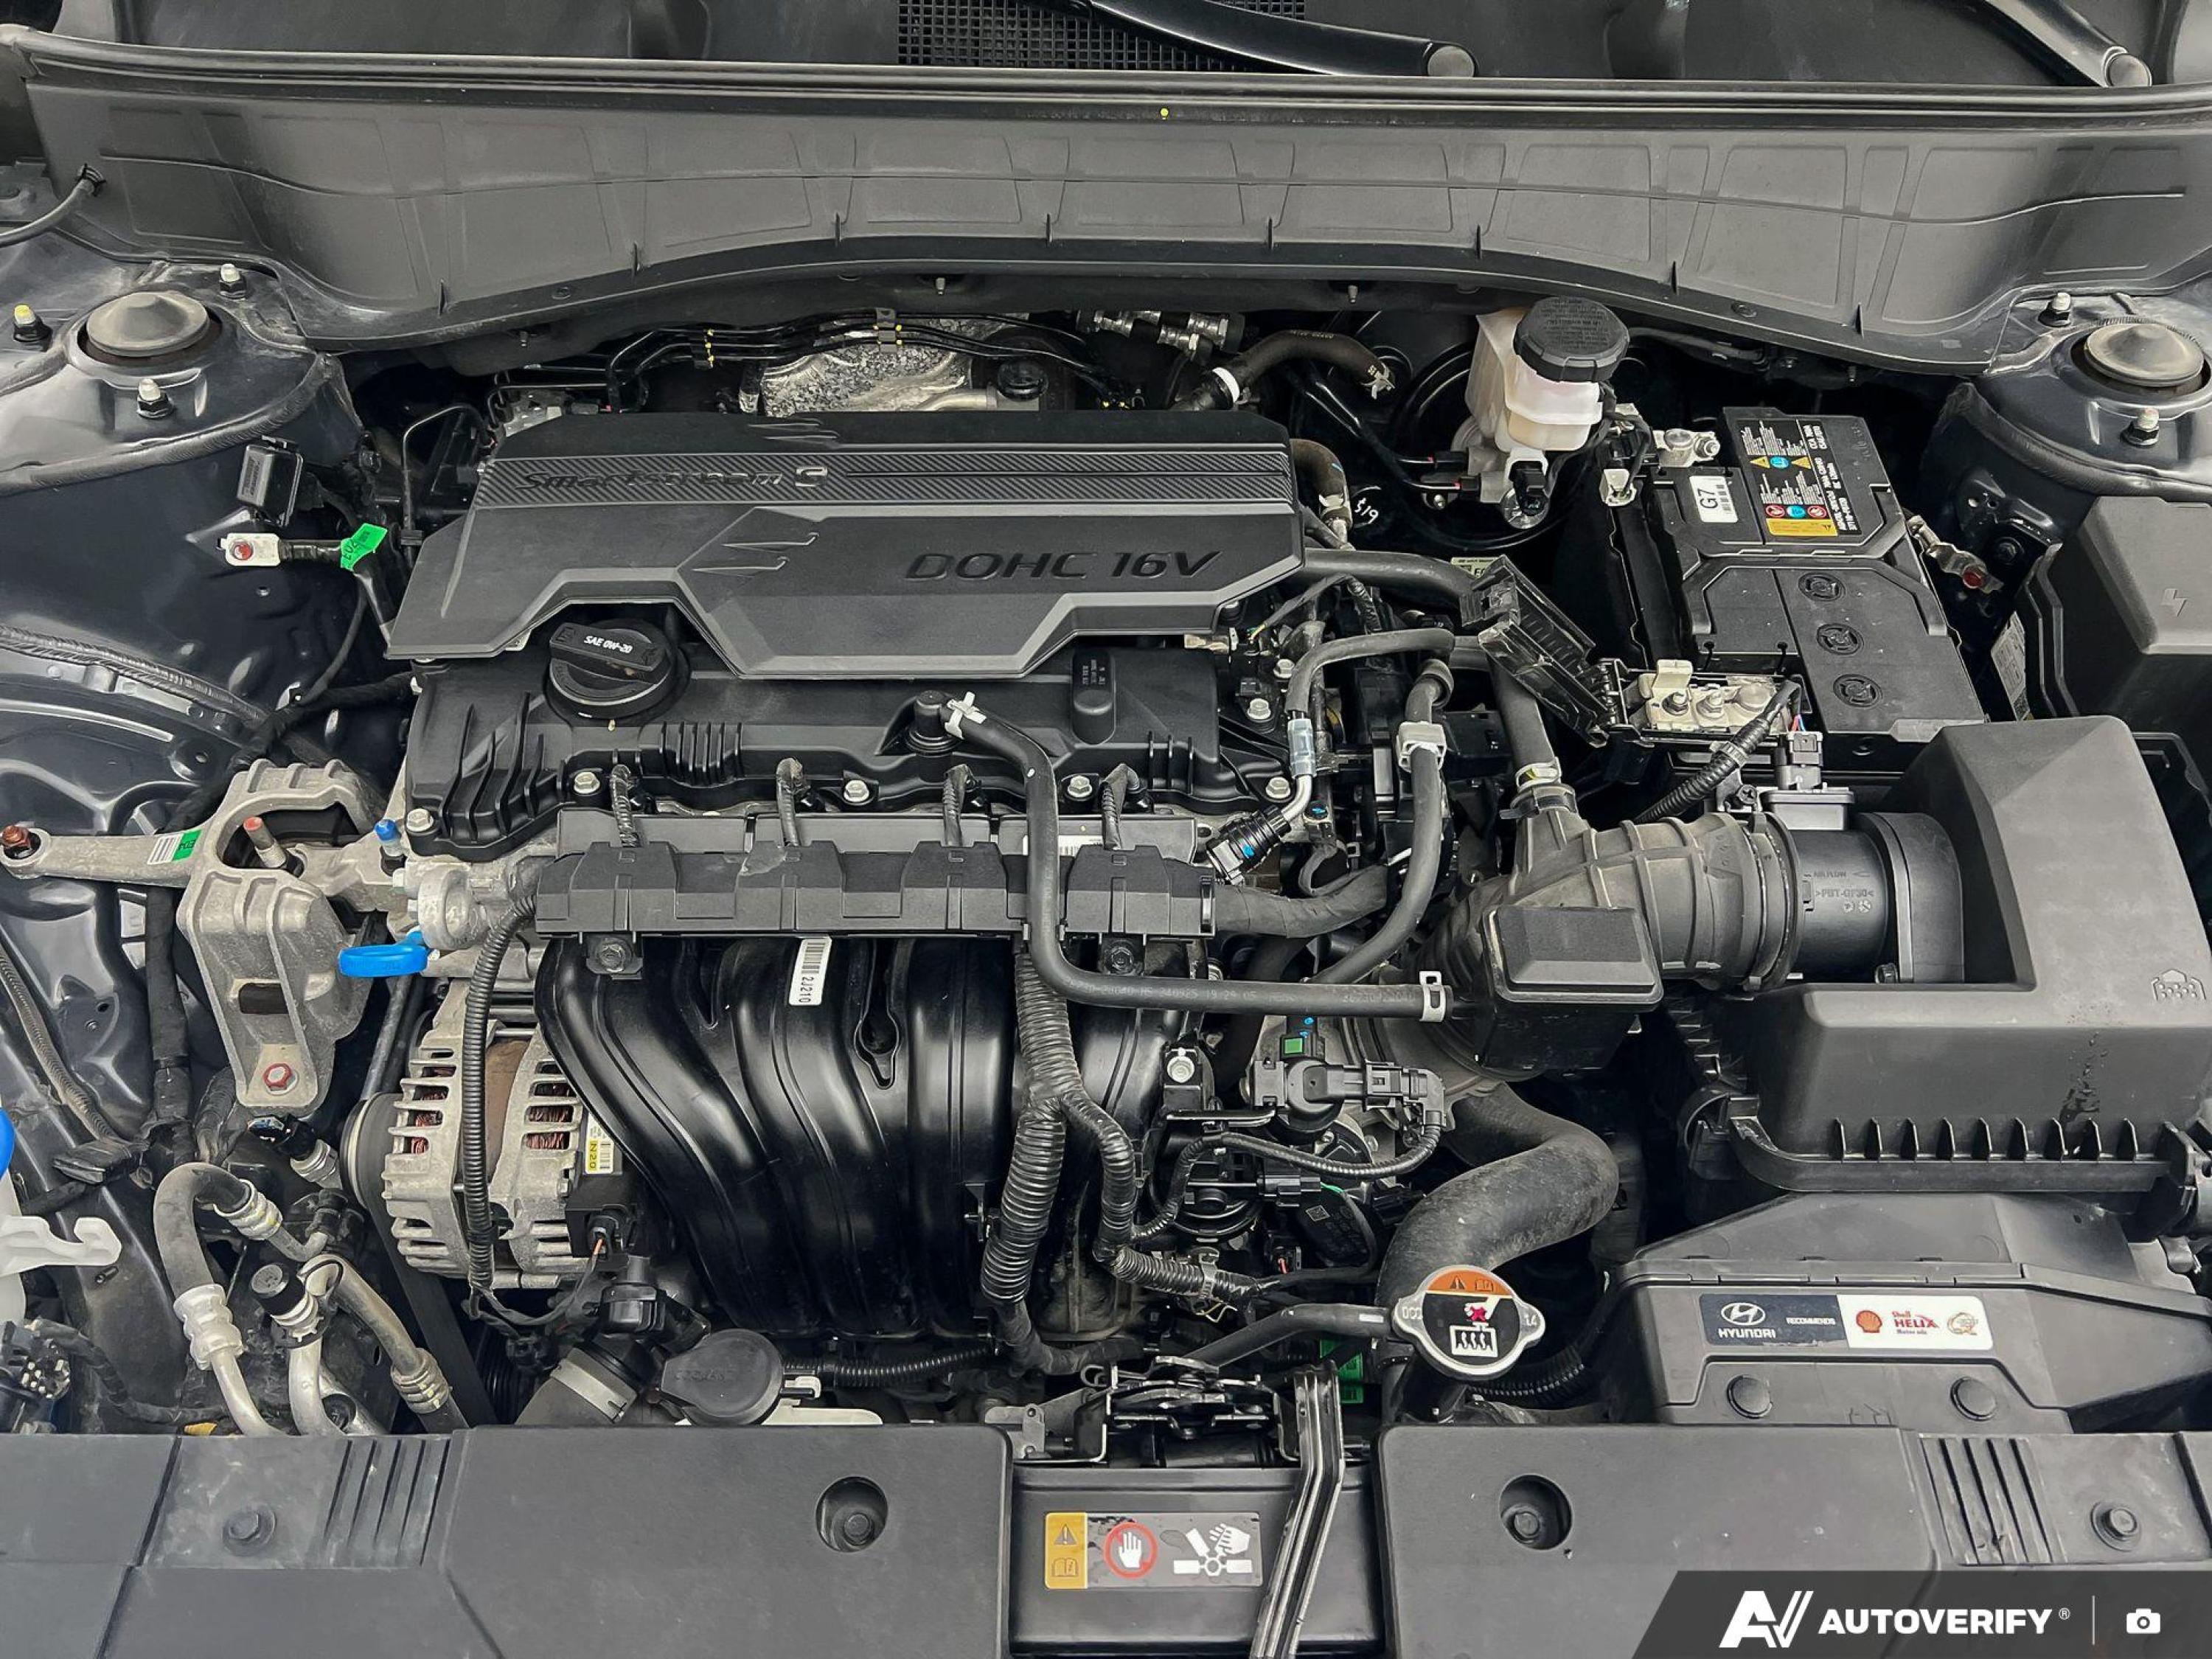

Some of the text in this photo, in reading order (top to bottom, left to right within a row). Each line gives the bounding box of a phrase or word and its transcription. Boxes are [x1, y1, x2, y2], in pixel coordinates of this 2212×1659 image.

[1697, 487, 1718, 509] G7
[905, 550, 1222, 581] DOHC 16V
[583, 636, 633, 654] SAE 0W-20
[799, 976, 815, 1003] 2J210
[1718, 1327, 1776, 1338] HYUNDAI
